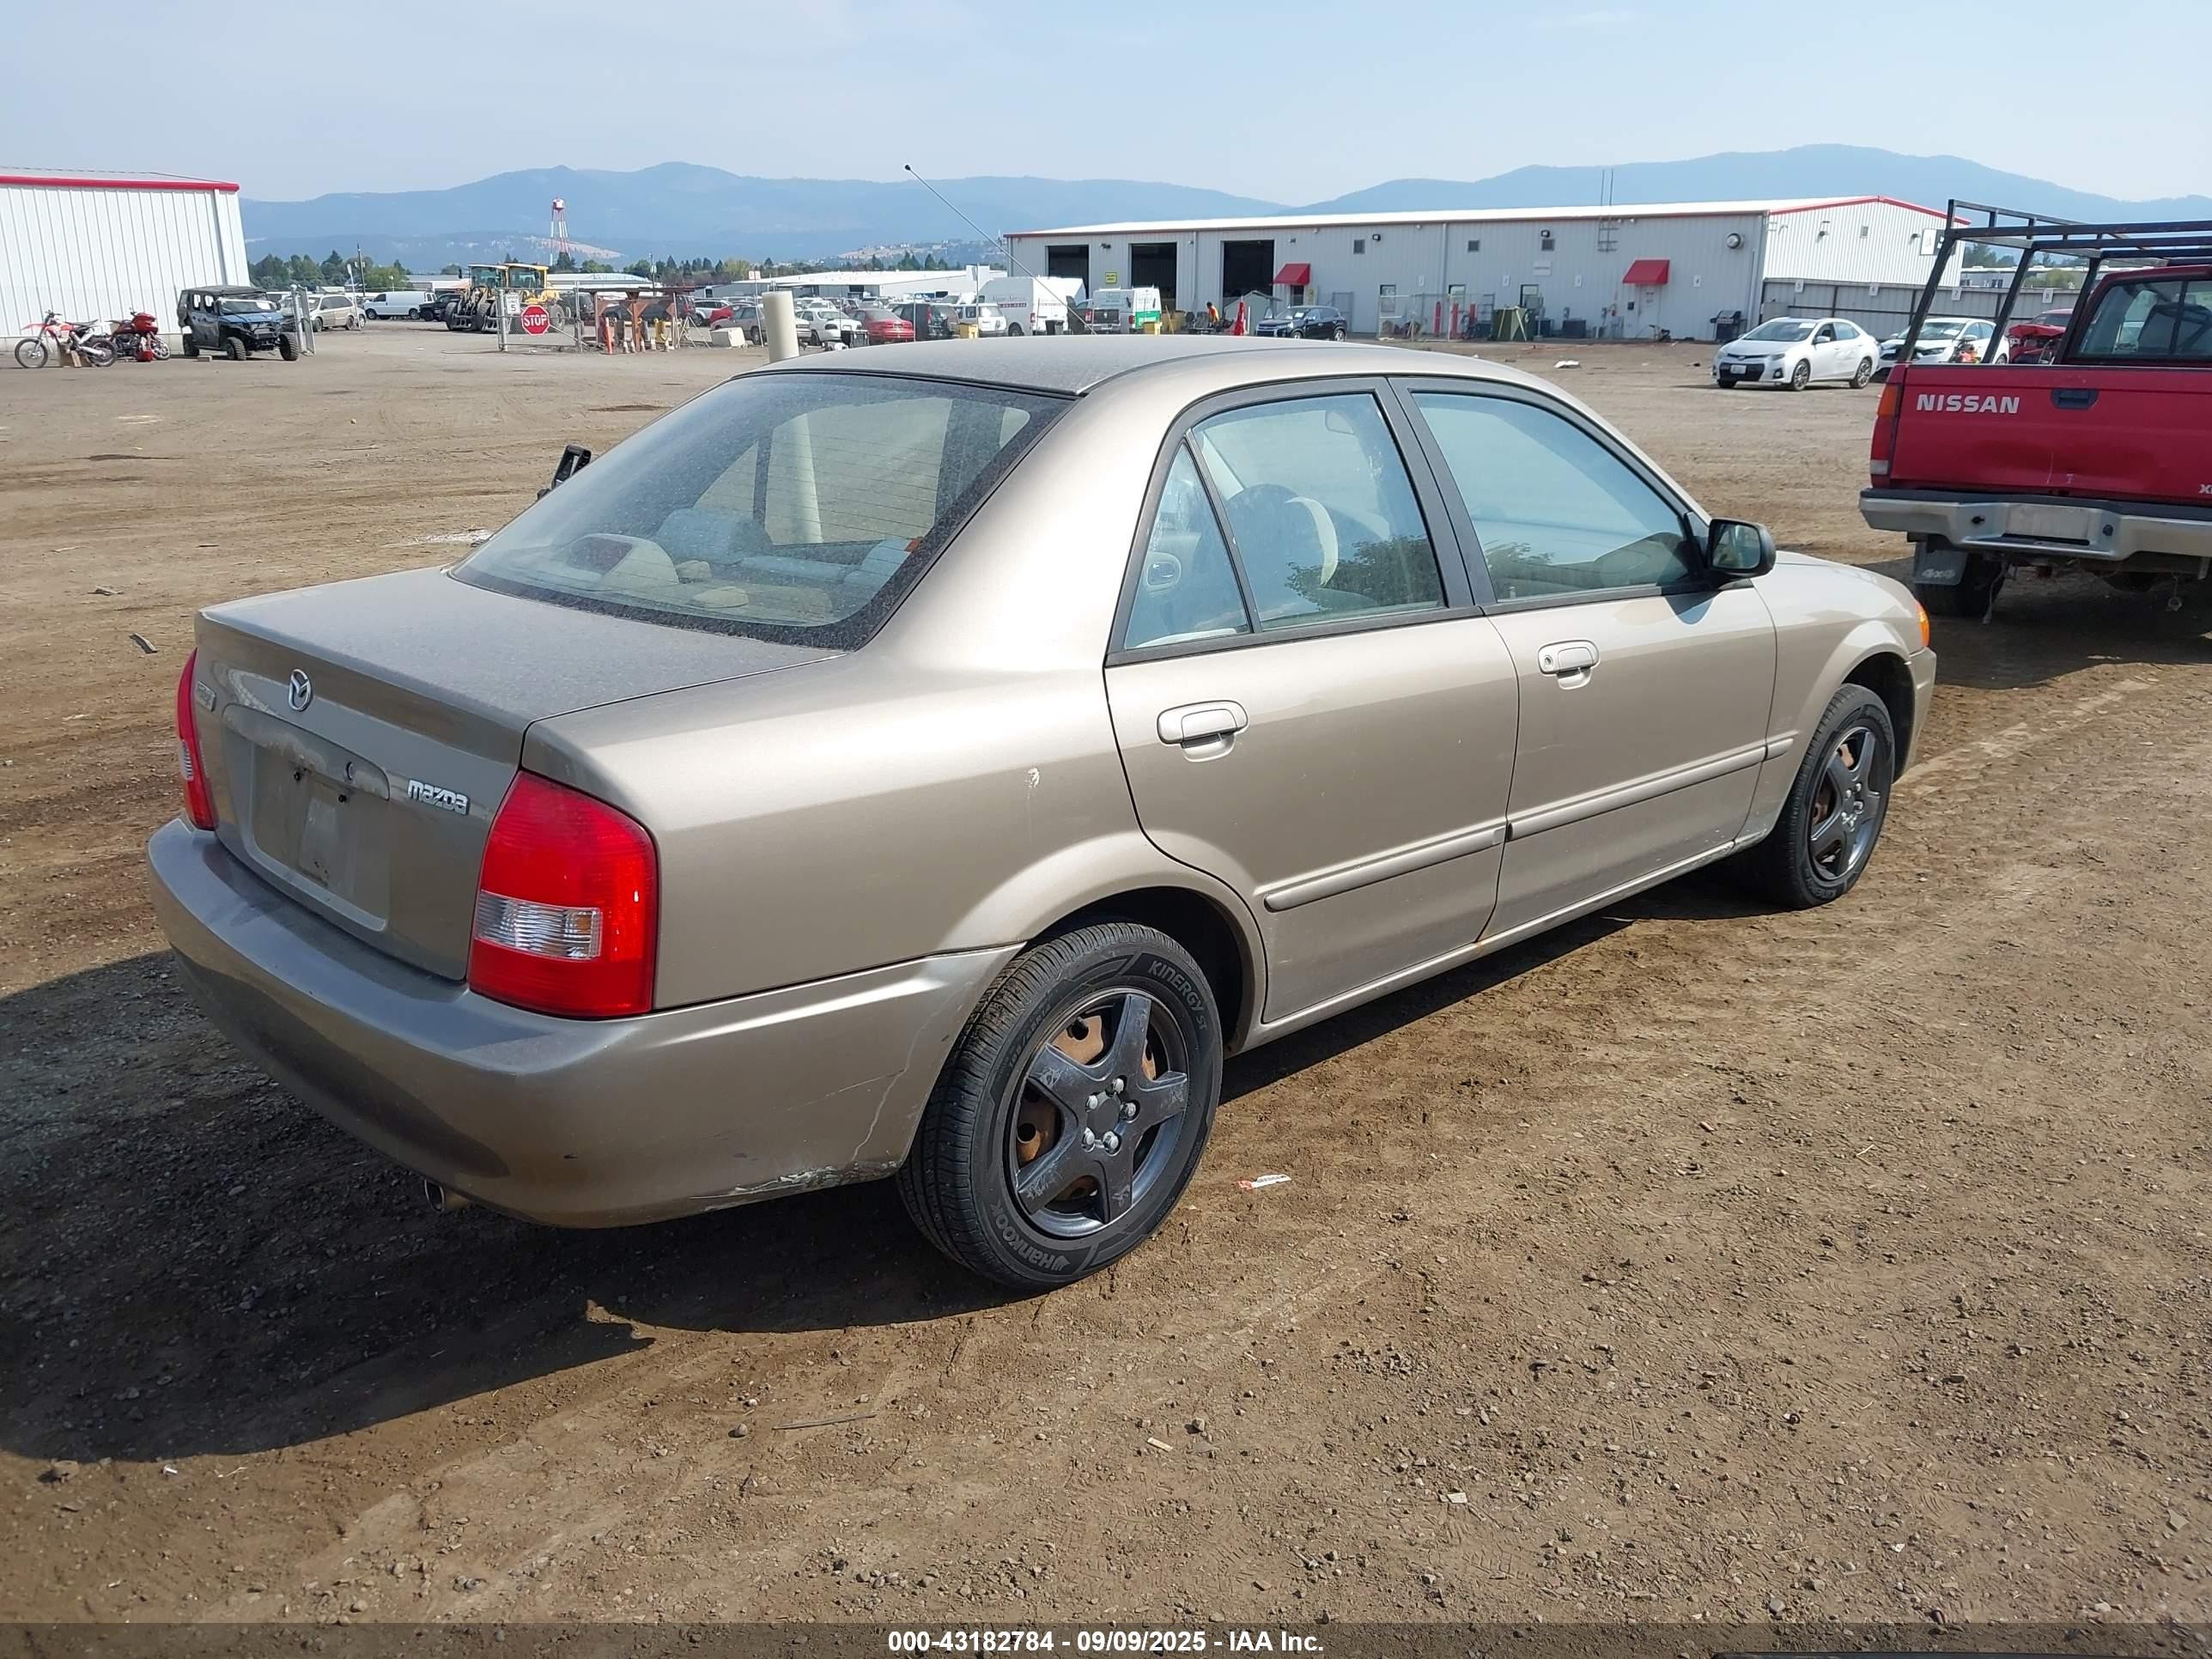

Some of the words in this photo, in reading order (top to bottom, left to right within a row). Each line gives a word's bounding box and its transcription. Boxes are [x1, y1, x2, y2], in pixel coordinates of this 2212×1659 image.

[524, 314, 547, 326] STOP
[1916, 394, 2020, 413] NISSAN
[408, 780, 468, 815] mazda
[1148, 960, 1204, 1011] KINERGY
[1195, 1015, 1207, 1030] ST
